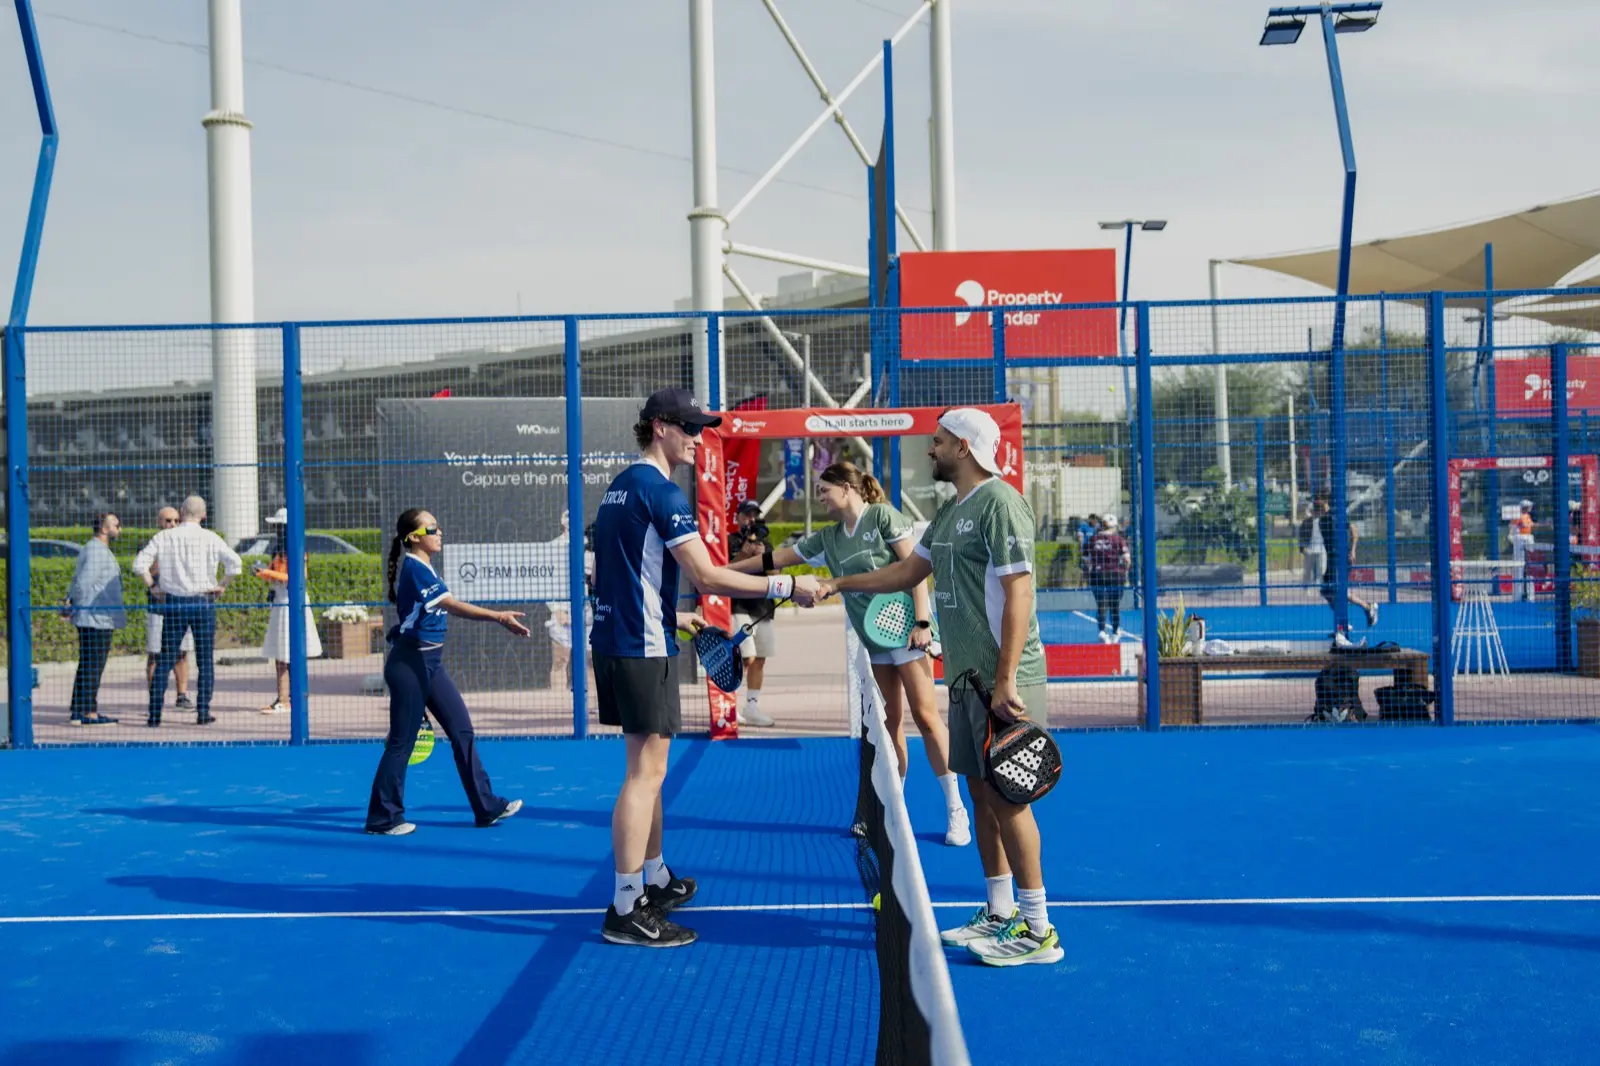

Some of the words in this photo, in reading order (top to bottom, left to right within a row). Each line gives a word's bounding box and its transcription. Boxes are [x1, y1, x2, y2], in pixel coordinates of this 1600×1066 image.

[988, 289, 1063, 305] Property
[849, 417, 878, 428] starts
[881, 417, 904, 427] here
[443, 452, 479, 466] Your
[481, 453, 513, 466] turn
[516, 452, 529, 466] in
[531, 451, 558, 466] the
[462, 471, 520, 488] Capture
[524, 471, 548, 485] the
[482, 566, 511, 578] TEAM
